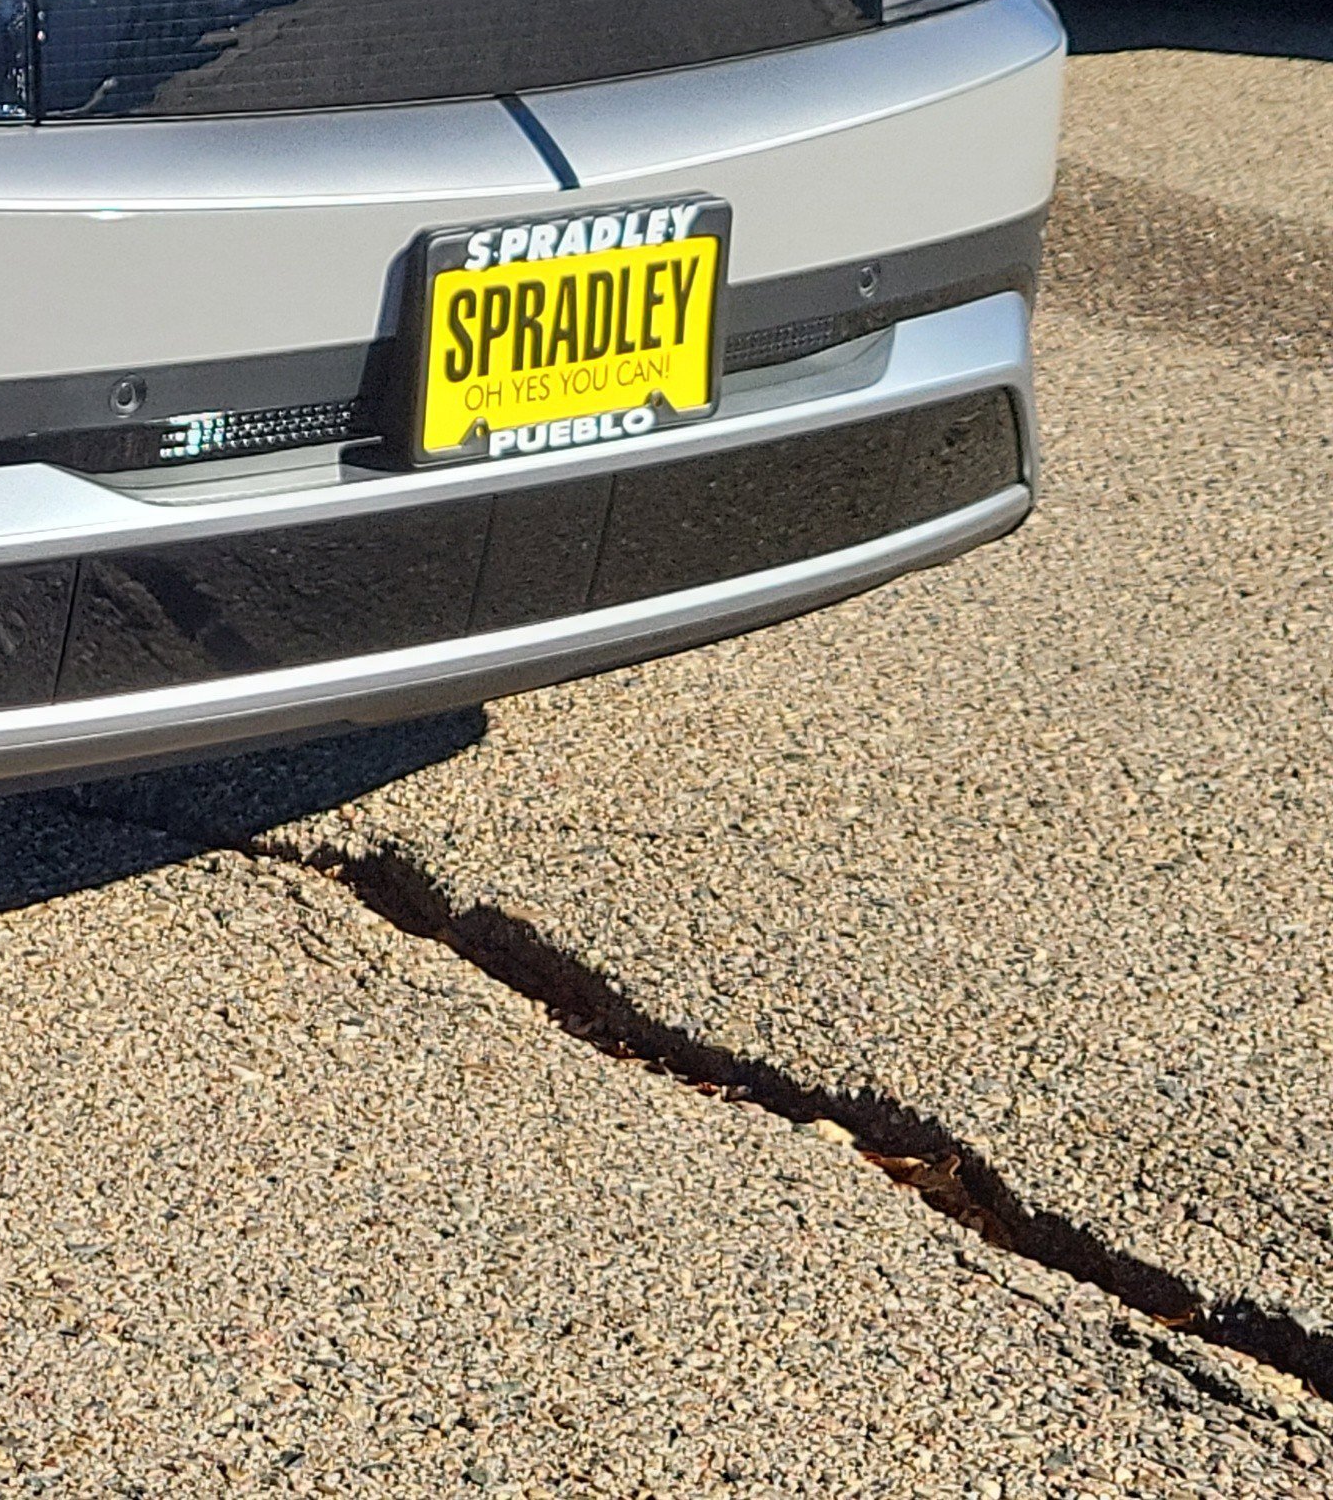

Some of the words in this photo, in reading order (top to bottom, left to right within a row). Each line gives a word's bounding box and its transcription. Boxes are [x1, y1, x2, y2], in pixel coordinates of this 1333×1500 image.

[464, 203, 700, 271] SPRADLEY
[444, 255, 700, 383] SPRADLEY
[464, 380, 502, 411] OH
[511, 374, 551, 403] YES
[559, 364, 608, 396] YOU
[617, 354, 670, 387] CAN!
[489, 406, 656, 457] PUEBLO
